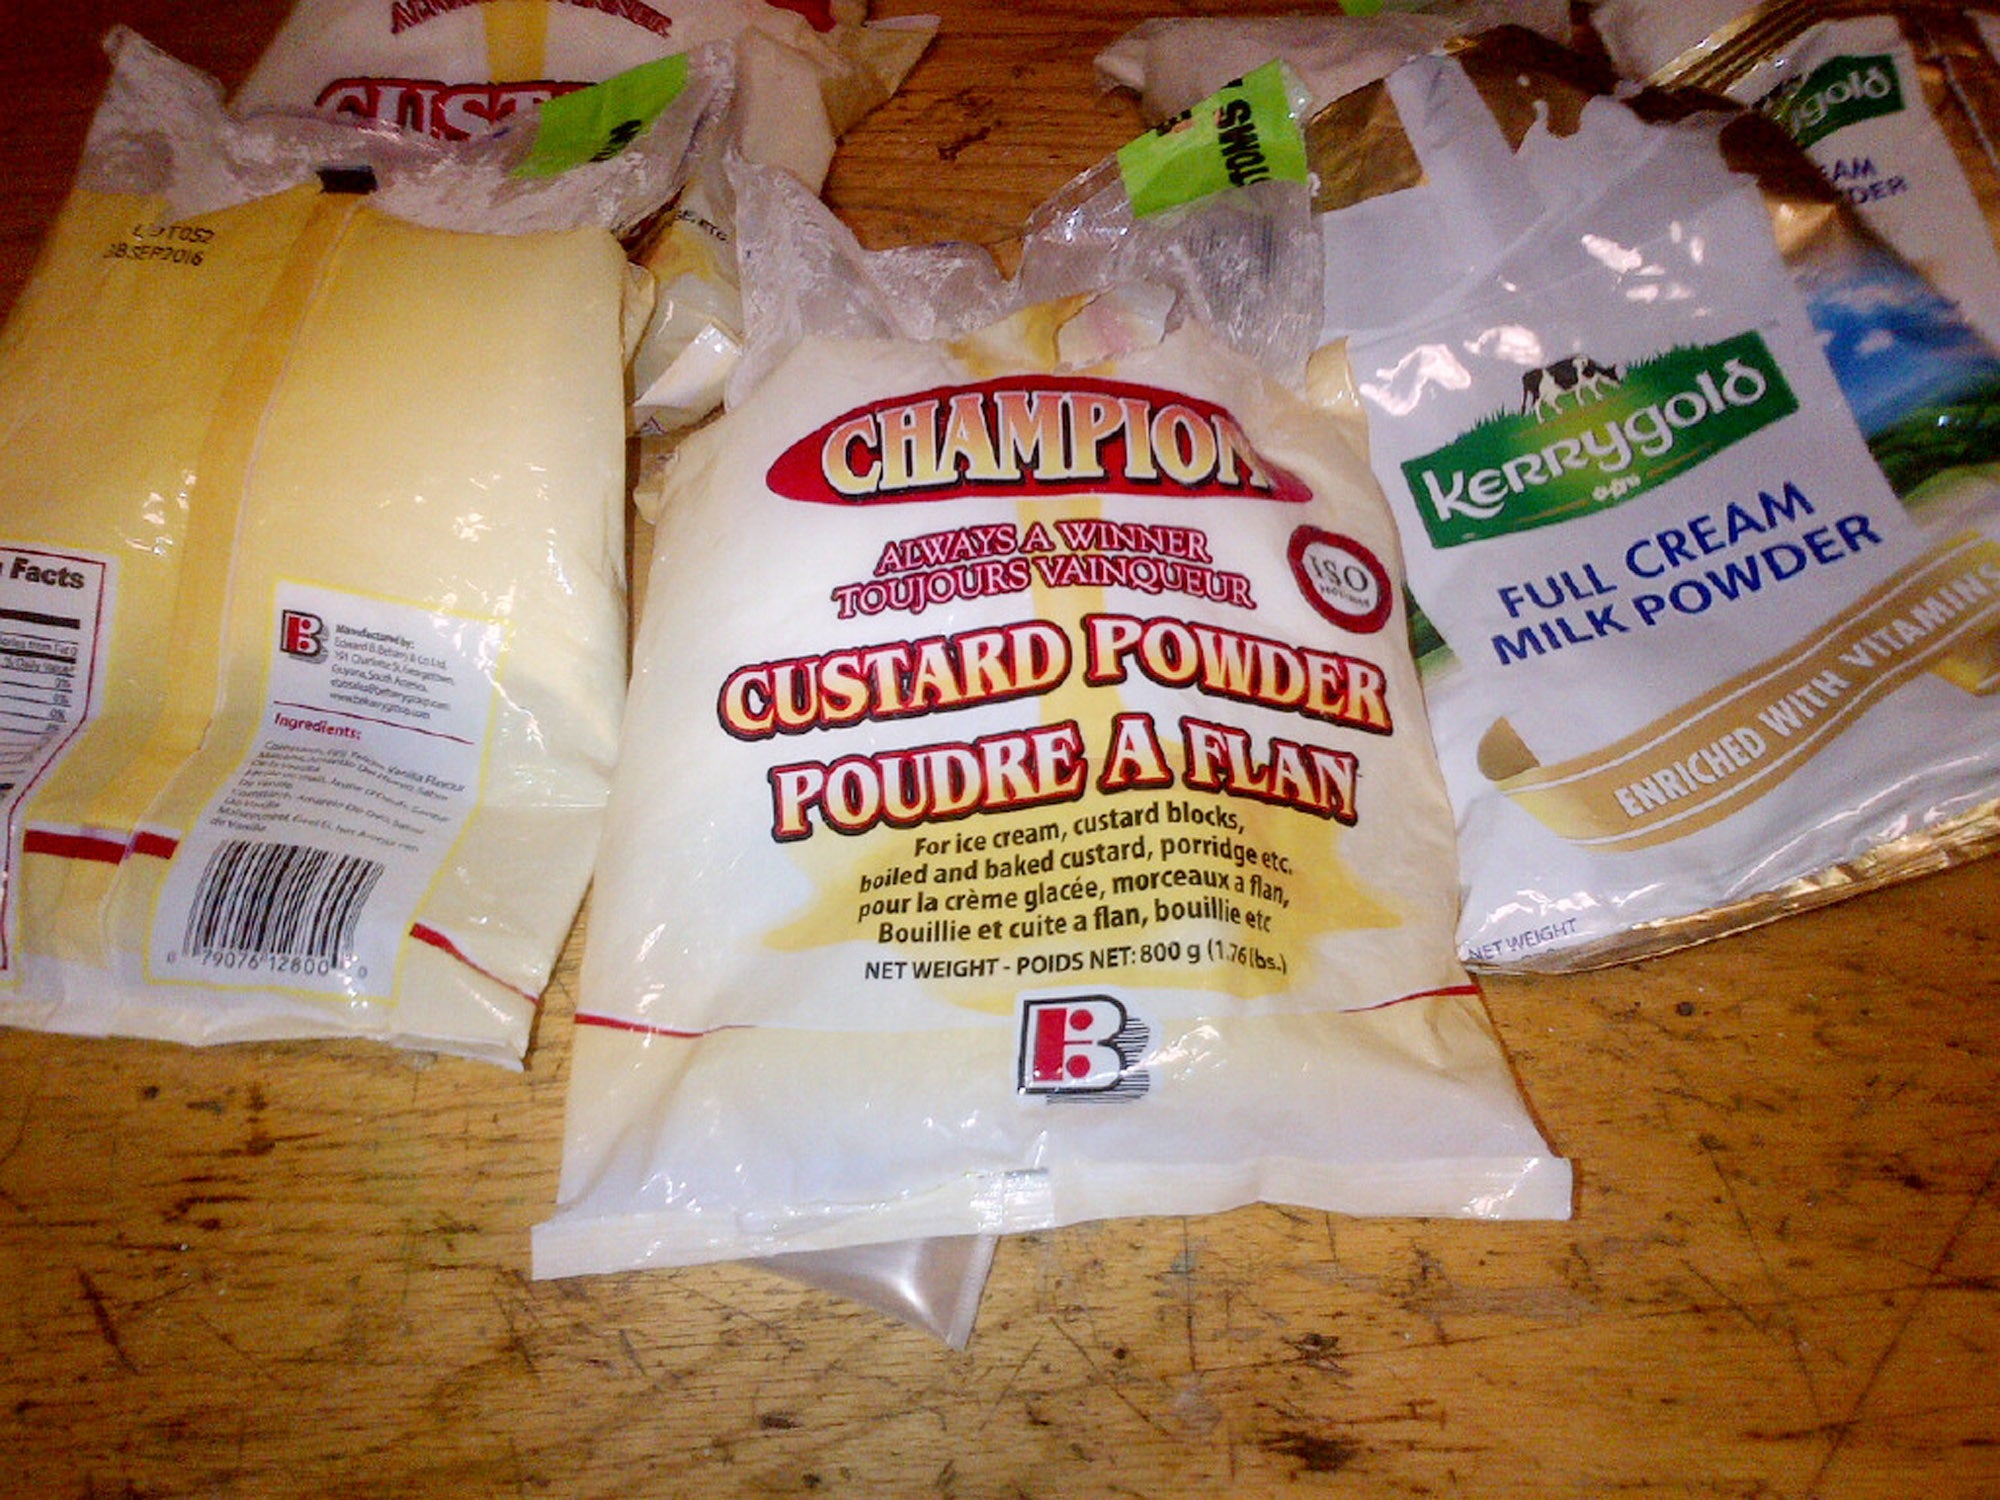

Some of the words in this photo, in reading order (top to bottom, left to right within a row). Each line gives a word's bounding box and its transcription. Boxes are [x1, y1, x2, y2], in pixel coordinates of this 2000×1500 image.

[821, 391, 1274, 497] CHAMPION
[1422, 358, 1766, 521] Kerrygold
[9, 557, 85, 589] Facts
[874, 522, 1018, 575] ALWAYS
[1019, 521, 1057, 553] A
[1054, 518, 1213, 563] WINNER
[1309, 554, 1368, 592] ISO
[1498, 562, 1617, 618] FULL
[1625, 481, 1815, 578] CREAM
[832, 556, 1030, 619] TOUJOURS
[1030, 555, 1257, 609] VAINQUEUR
[1491, 603, 1629, 666] MILK
[1632, 513, 1883, 626] POWDER
[717, 619, 1073, 739] CUSTARD
[1083, 614, 1393, 736] POWDER
[274, 712, 362, 741] Ingredients:
[1614, 727, 1768, 818] ENRICHED
[1758, 669, 1843, 738] WITH
[770, 719, 1088, 842] POUDRE
[1103, 711, 1172, 795] A
[1181, 716, 1360, 827] FLAN
[914, 837, 950, 857] For
[956, 833, 987, 854] ice
[993, 822, 1067, 848] cream,
[1073, 801, 1159, 836] custard
[1167, 801, 1246, 834] blocks,
[860, 863, 928, 893] boiled
[933, 859, 978, 884] and
[985, 849, 1054, 880] baked
[1060, 835, 1153, 870] custard,
[1160, 836, 1258, 868] porridge
[1261, 850, 1294, 875] etc.
[858, 897, 912, 923] pour
[916, 891, 939, 912] la
[945, 889, 1018, 911] crème
[1024, 875, 1106, 912] glacée,
[1112, 868, 1230, 894] morceaux
[1234, 875, 1245, 893] a
[1250, 874, 1290, 908] flan,
[878, 919, 971, 944] Bouillie
[978, 920, 1003, 941] et
[1009, 914, 1067, 939] cuite
[1073, 914, 1087, 932] a
[1094, 905, 1149, 930] flan,
[1154, 895, 1241, 926] bouillie
[1245, 911, 1273, 934] etc
[201, 948, 260, 971] 79076
[865, 961, 907, 980] NET
[912, 957, 1000, 980] WEIGHT
[1016, 952, 1084, 976] POIDS
[1089, 945, 1136, 971] NET:
[1140, 941, 1181, 964] 800
[1187, 944, 1201, 964] g
[1468, 939, 1503, 960] NET
[1507, 917, 1577, 952] WEIGHT
